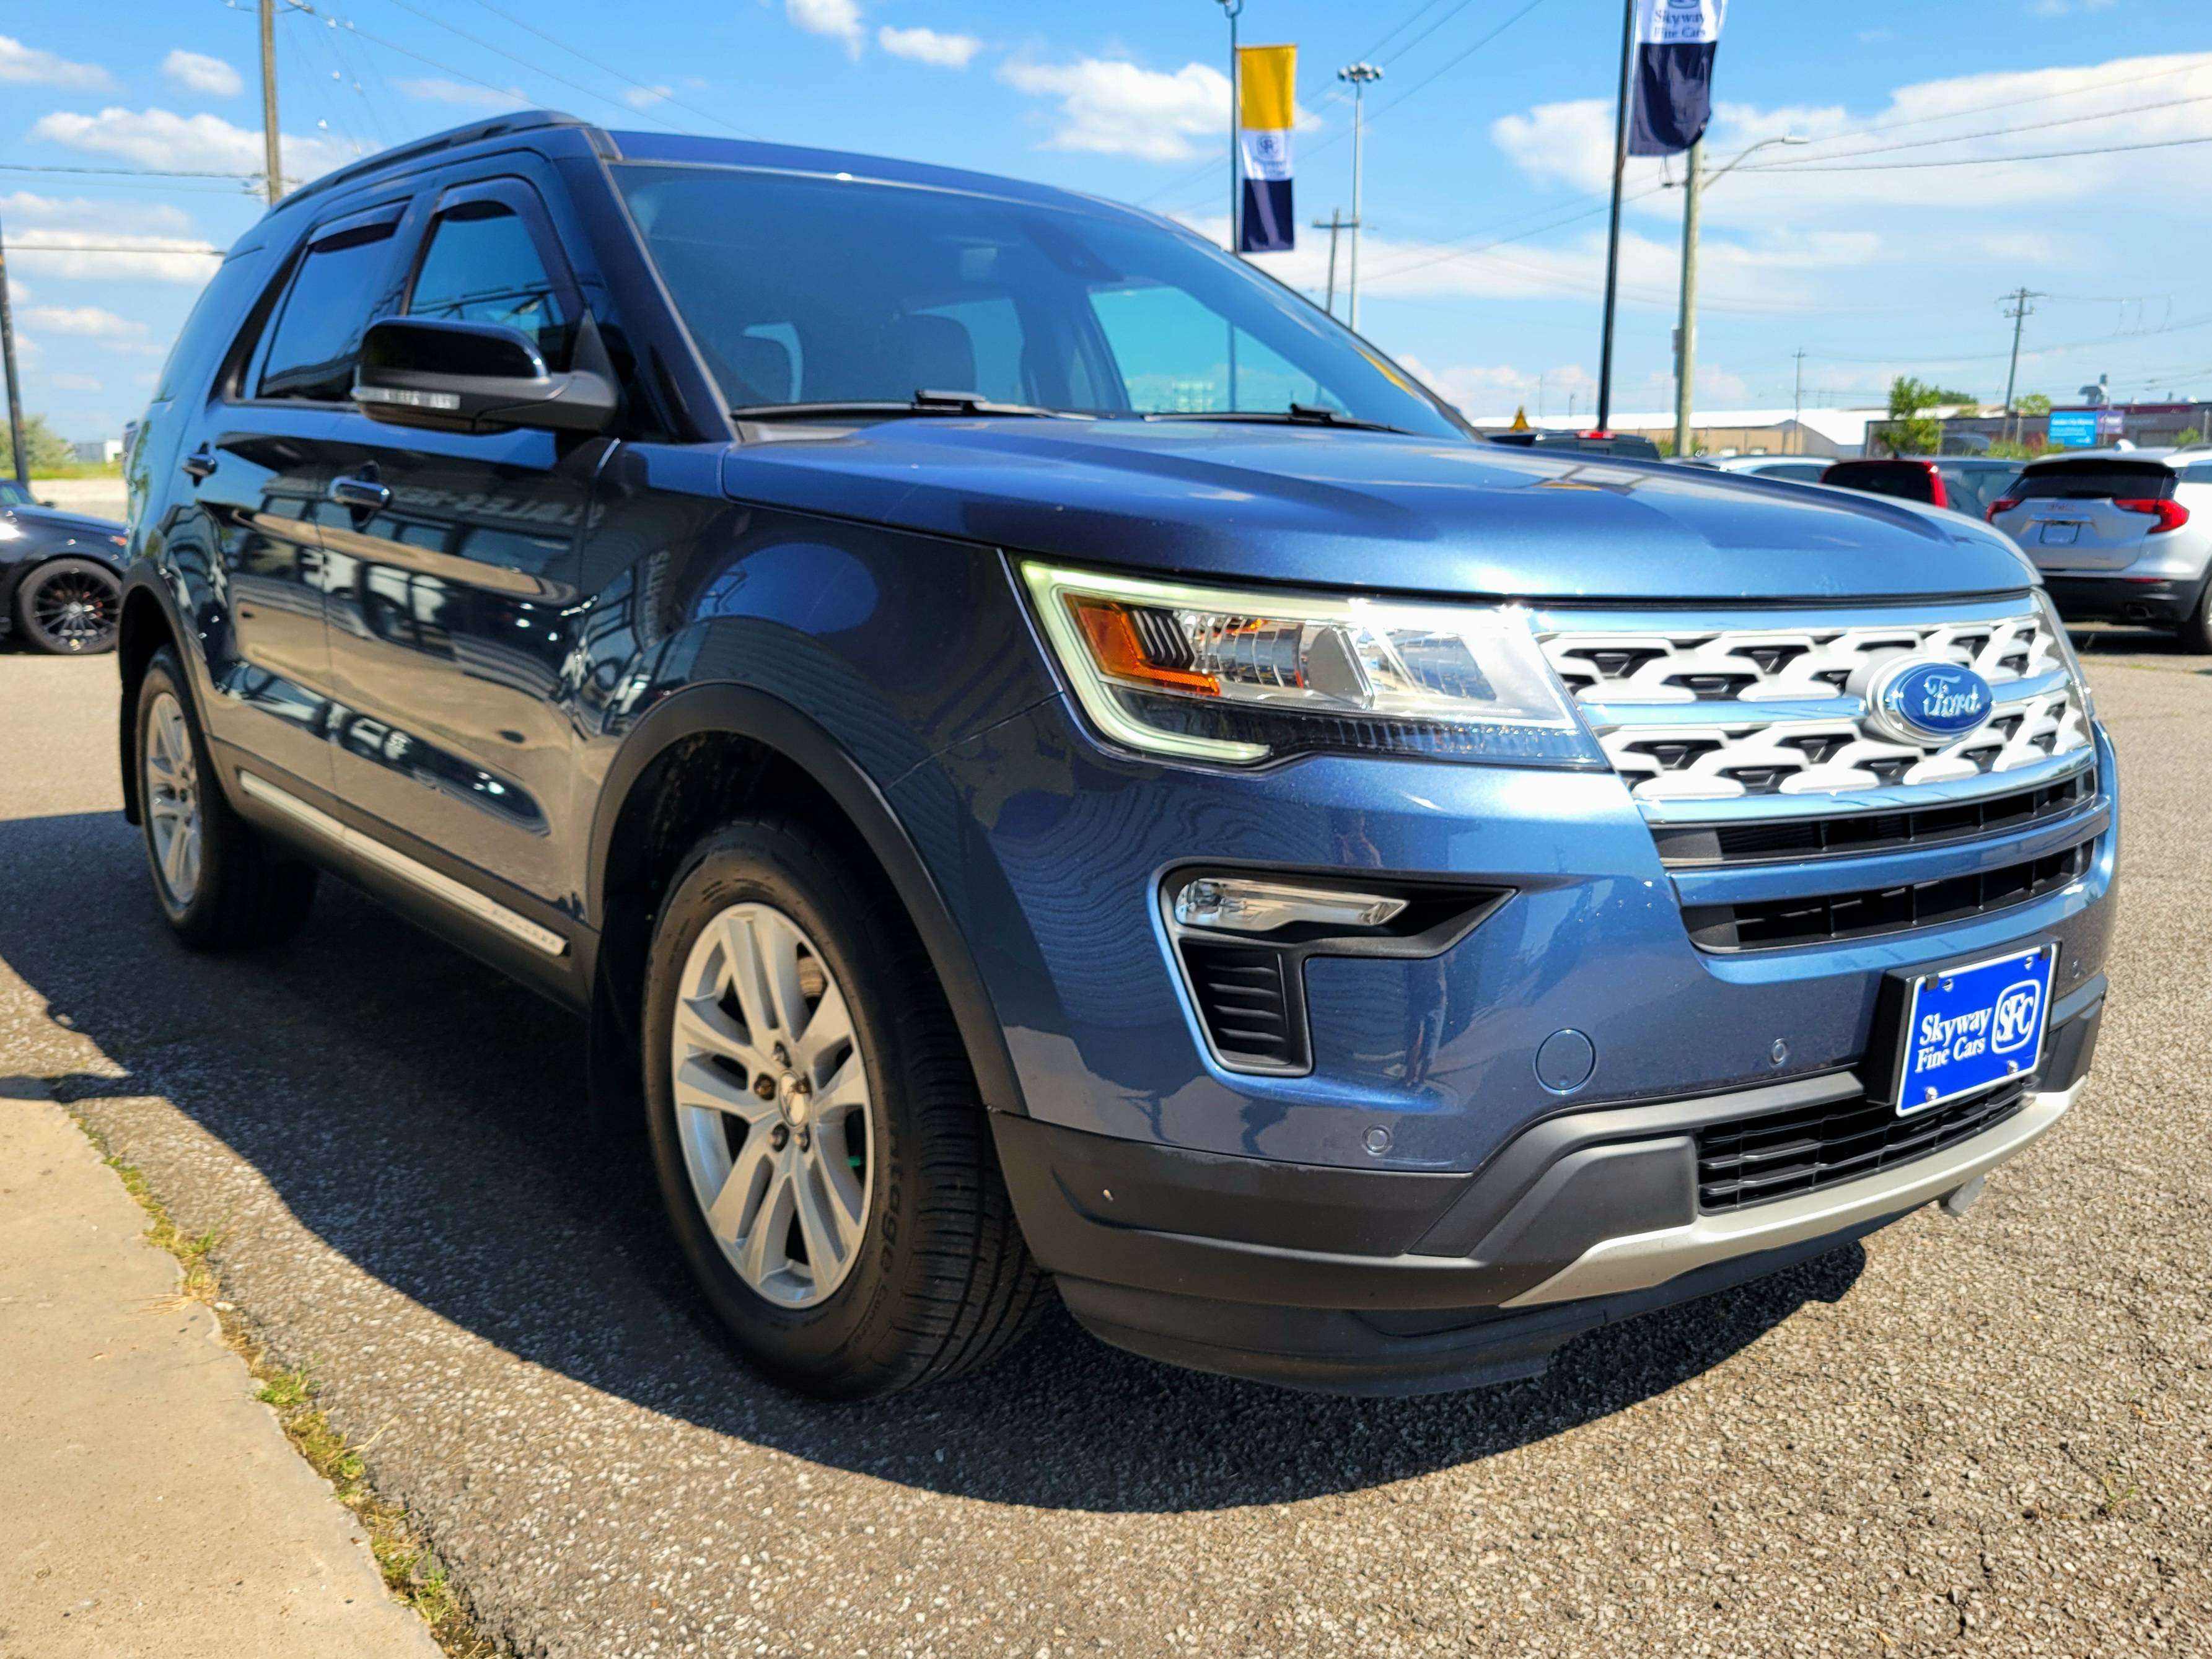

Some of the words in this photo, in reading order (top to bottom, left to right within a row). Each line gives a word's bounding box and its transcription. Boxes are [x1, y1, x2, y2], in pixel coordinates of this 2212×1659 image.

[1654, 9, 1705, 24] Skyway
[1923, 674, 1982, 717] Ford
[1919, 1006, 1993, 1047] Skyway
[1995, 992, 2034, 1043] SFC
[1914, 1045, 1951, 1074] Fine
[1952, 1035, 1986, 1062] Cars
